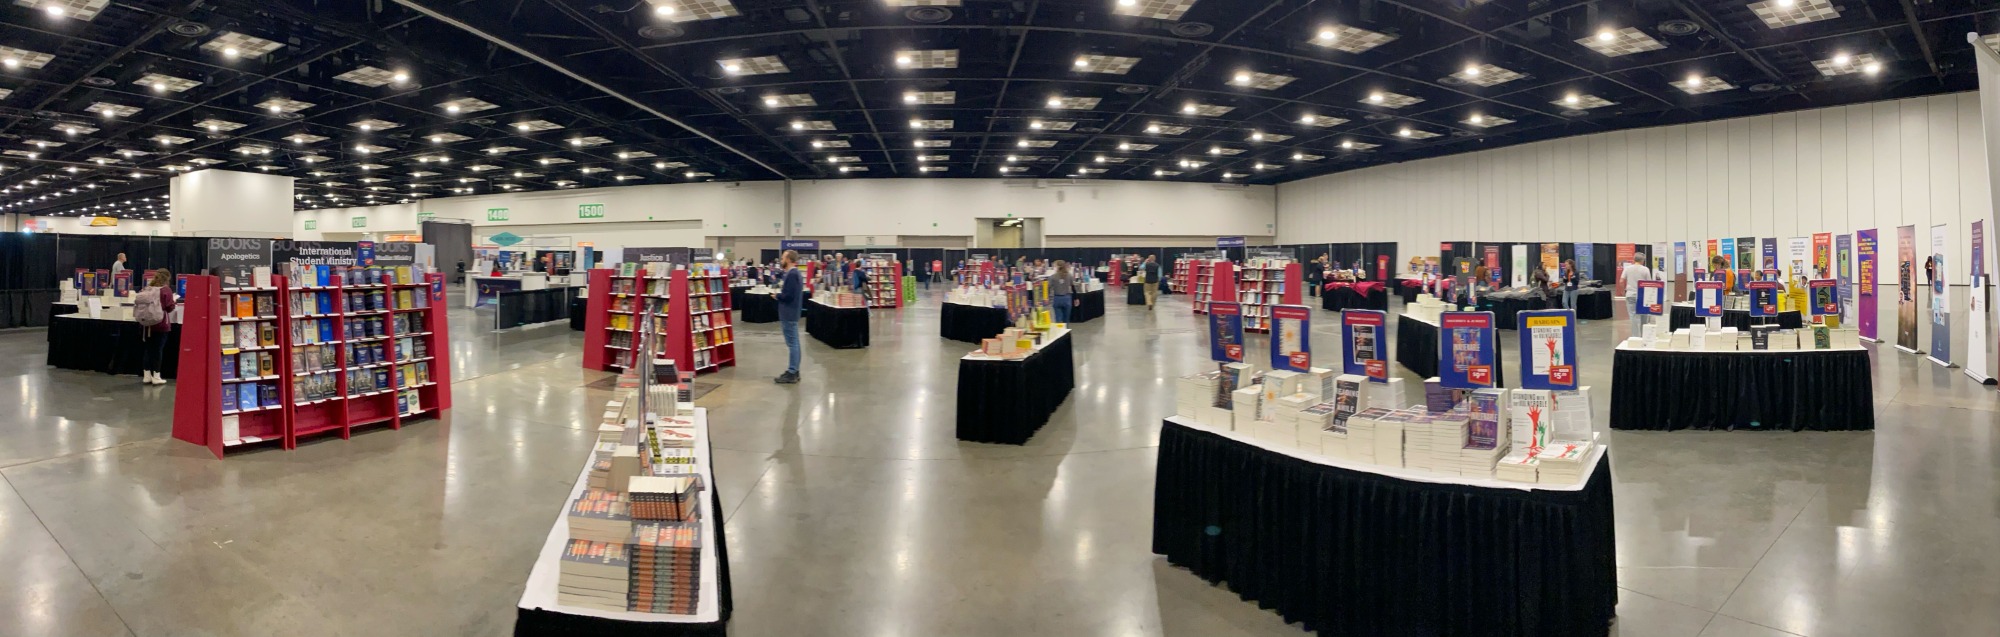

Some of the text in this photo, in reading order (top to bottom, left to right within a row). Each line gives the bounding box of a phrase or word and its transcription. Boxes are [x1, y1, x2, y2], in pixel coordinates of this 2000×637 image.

[488, 209, 508, 220] 1400
[580, 205, 603, 217] 1500
[209, 238, 261, 250] BOOKS
[299, 246, 351, 256] International
[221, 252, 260, 261] Apologetics
[290, 256, 324, 266] Student
[639, 253, 664, 261] Justice
